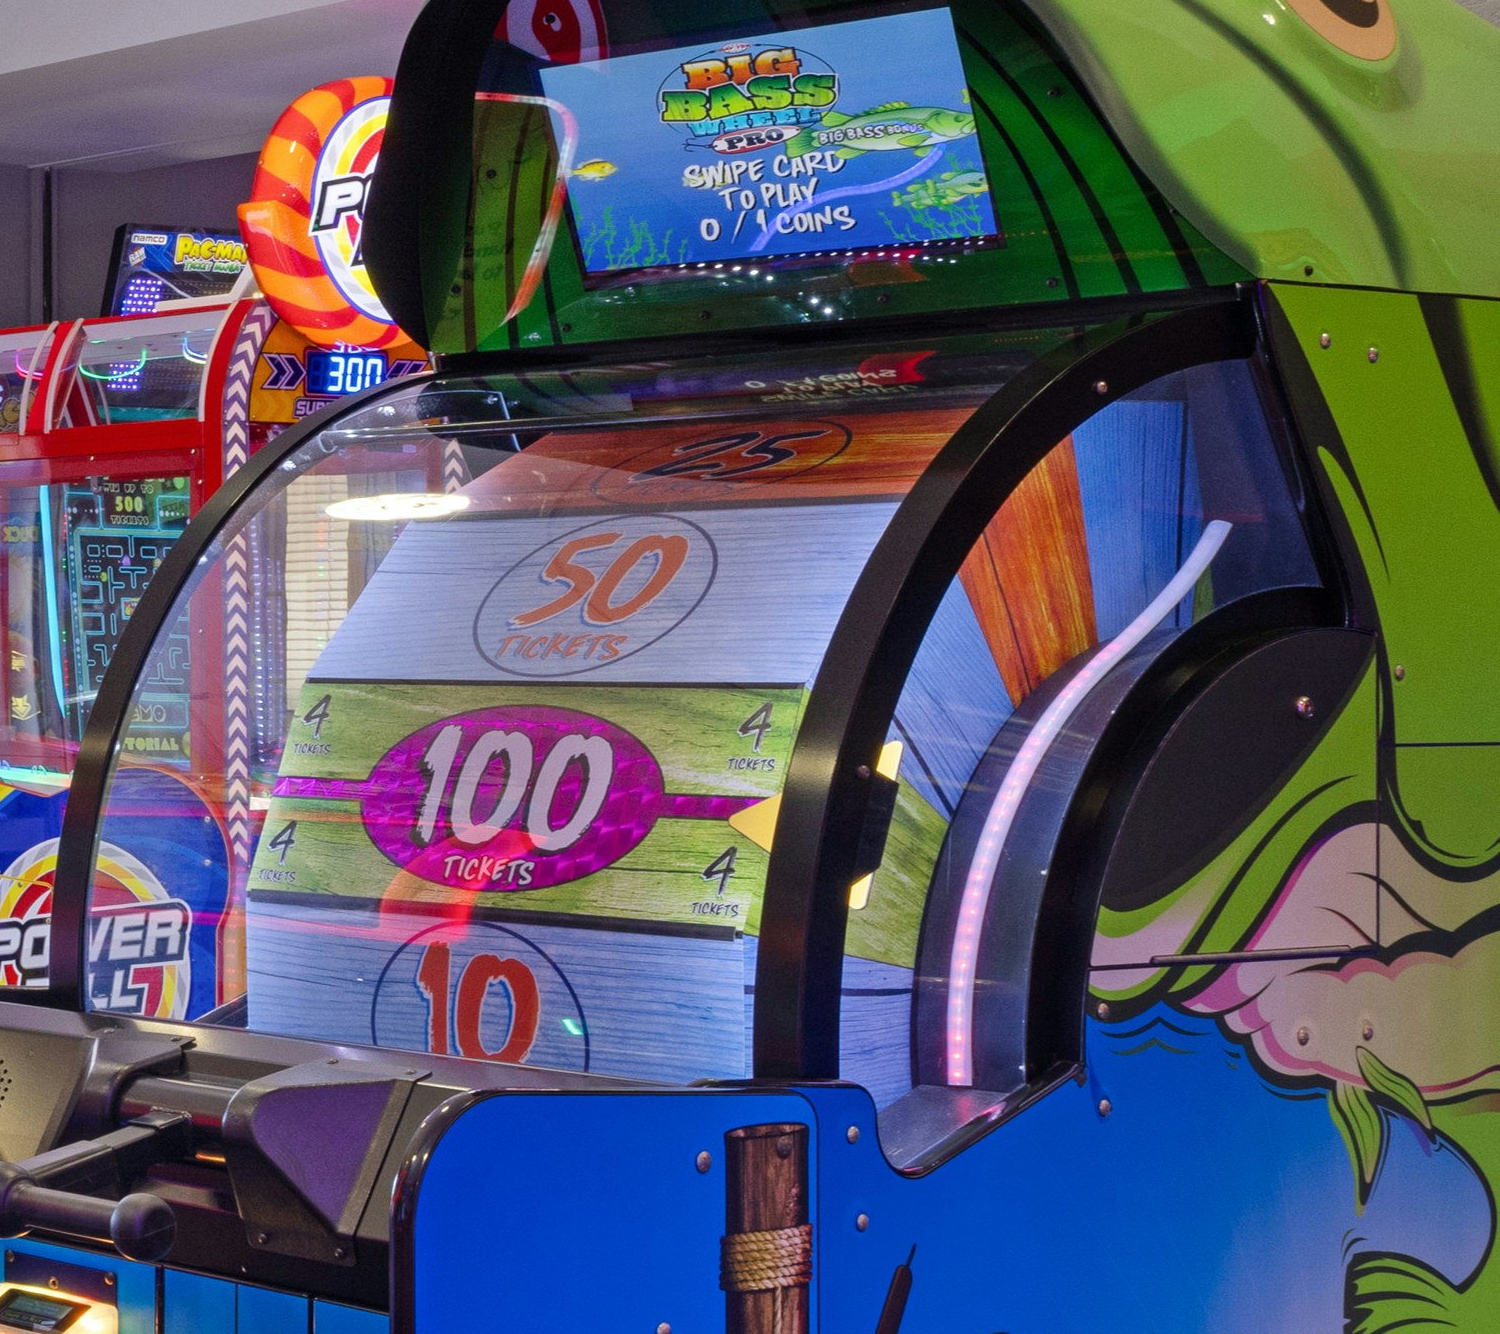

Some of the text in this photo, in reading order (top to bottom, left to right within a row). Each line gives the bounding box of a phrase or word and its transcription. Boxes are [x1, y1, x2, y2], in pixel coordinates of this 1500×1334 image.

[681, 47, 802, 91] BIG
[661, 73, 837, 123] BASS
[686, 106, 823, 137] WHEEL
[818, 123, 924, 146] BIG BASS BONUS
[725, 128, 785, 151] PRO
[683, 151, 846, 188] SWIPE CARD
[719, 177, 819, 211] TO PLAY
[776, 205, 857, 235] COINS
[133, 234, 165, 243] namco
[327, 356, 383, 392] 300
[626, 430, 833, 483] 25
[115, 496, 143, 512] 500
[509, 531, 690, 628] 50
[497, 633, 629, 662] TICKETS
[293, 741, 332, 757] TICKETS
[727, 756, 776, 773] TICKETS
[412, 723, 615, 852] 100
[258, 869, 297, 884] TICKETS
[443, 855, 534, 887] TICKETS
[690, 900, 740, 918] TICKETS
[417, 940, 540, 1065] 10
